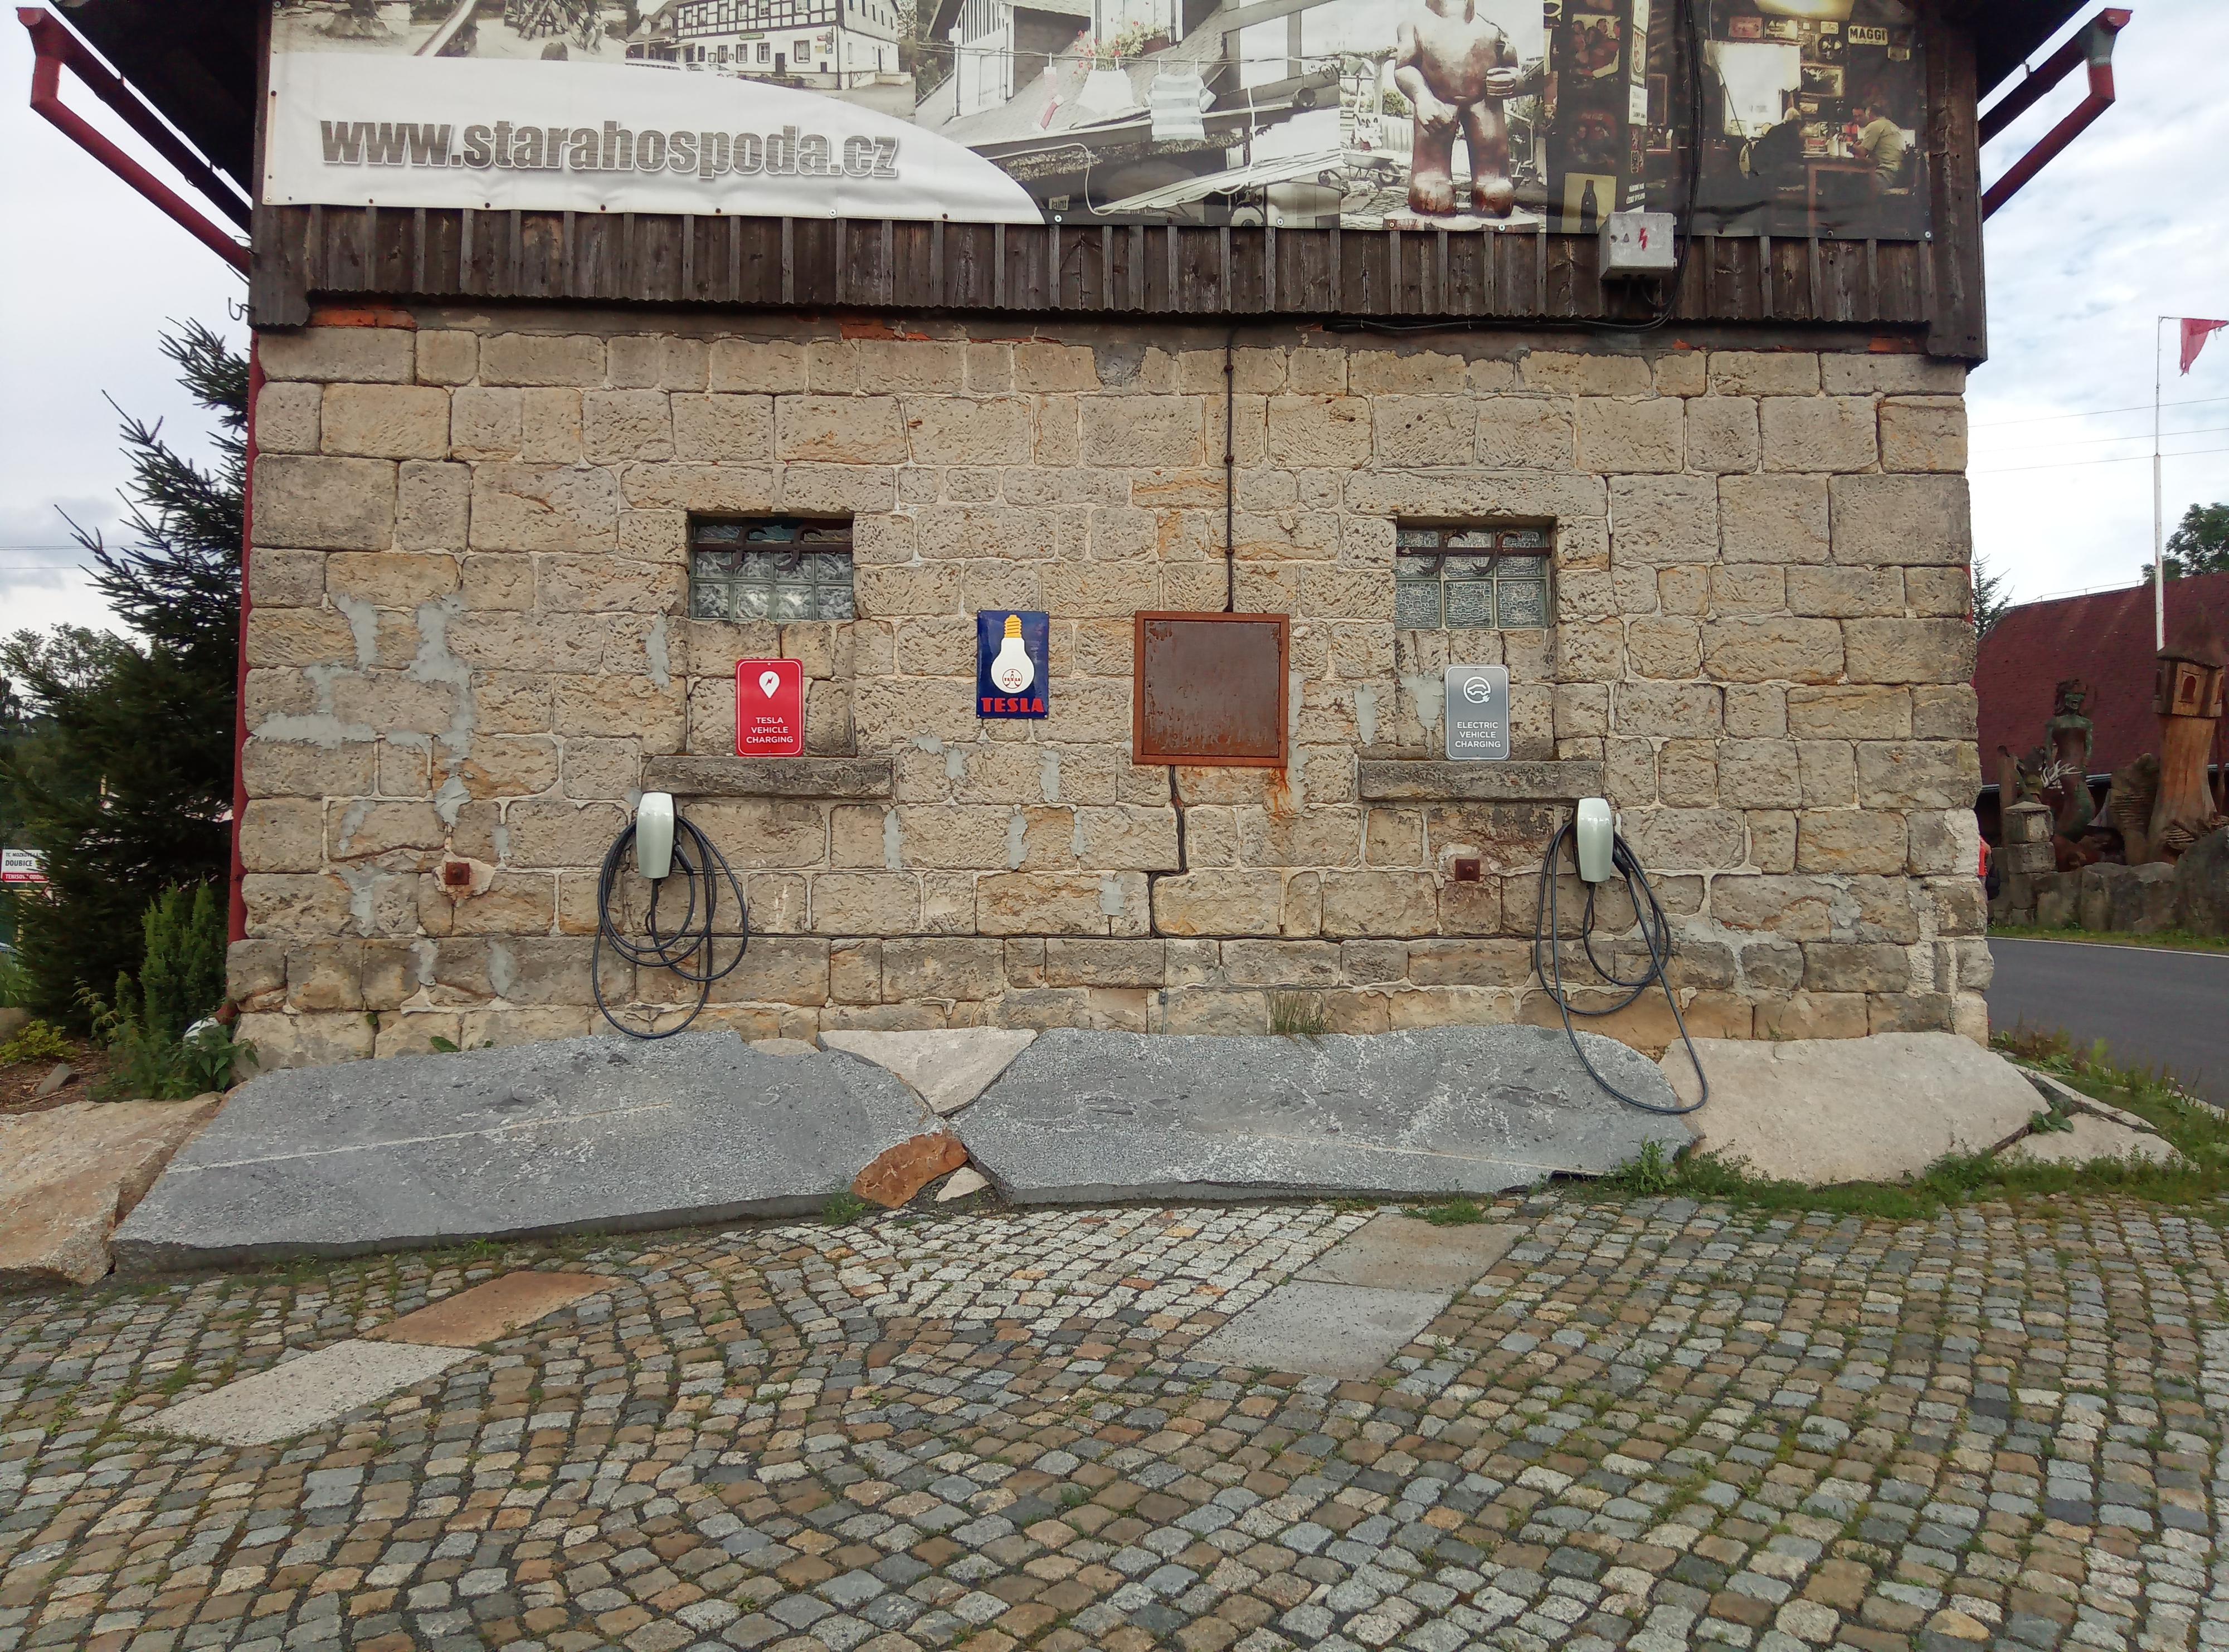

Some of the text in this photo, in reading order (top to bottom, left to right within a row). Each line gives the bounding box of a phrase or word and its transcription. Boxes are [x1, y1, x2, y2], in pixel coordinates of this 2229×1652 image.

[1850, 27, 1886, 41] MAGGI
[319, 120, 898, 179] www.starahospoda.cz
[981, 697, 1044, 713] TESLA
